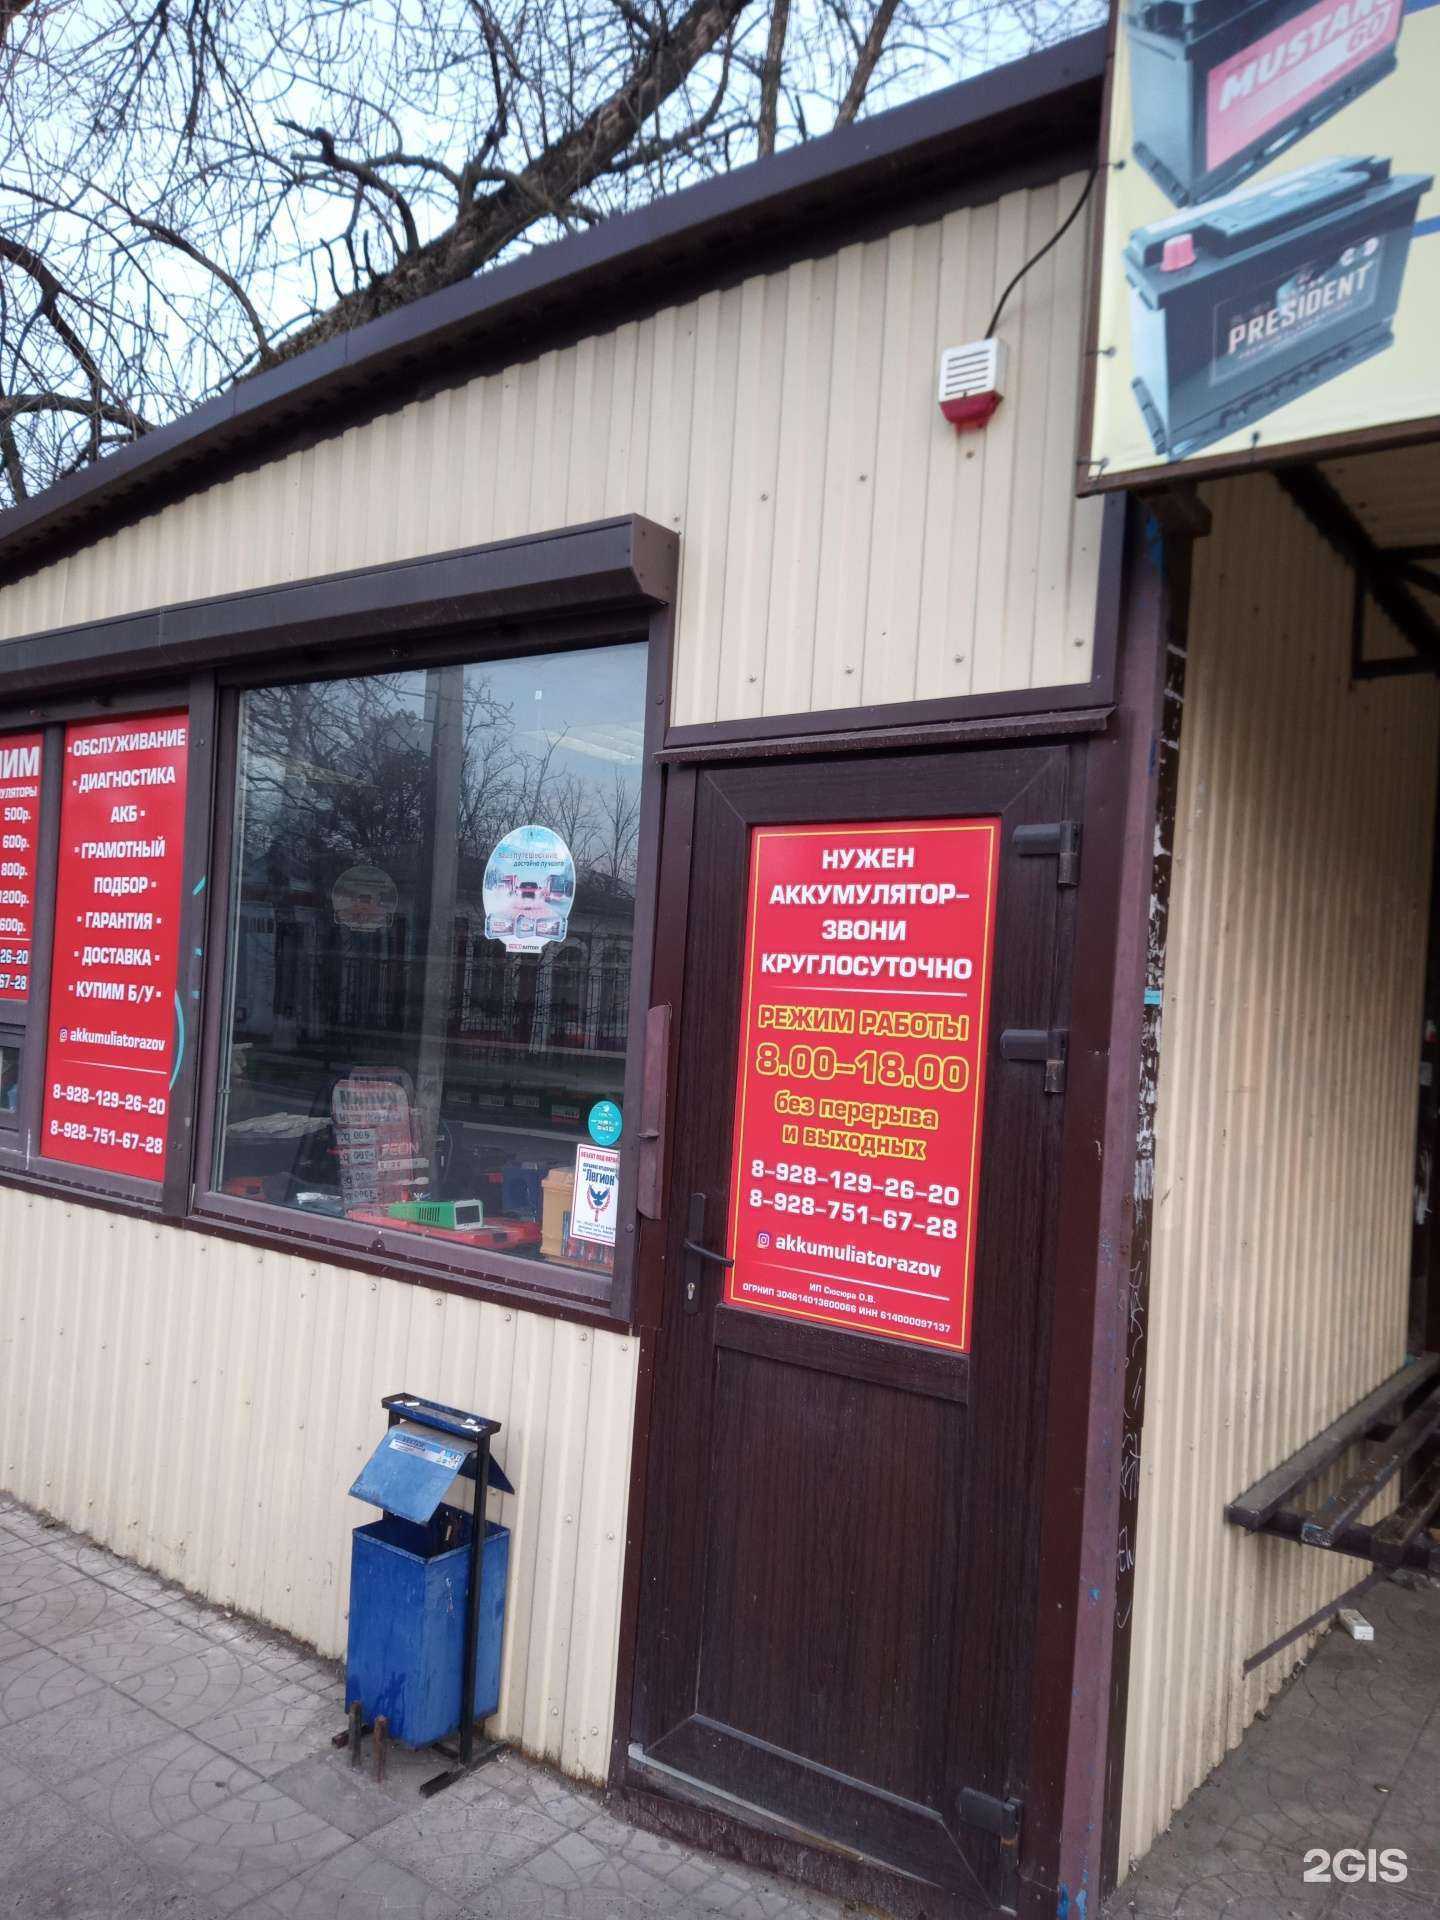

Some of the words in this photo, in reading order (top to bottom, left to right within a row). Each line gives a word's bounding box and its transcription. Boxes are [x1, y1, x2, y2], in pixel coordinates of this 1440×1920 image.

[1219, 0, 1386, 111] MUSTAN
[1228, 260, 1374, 354] PRESIDENT
[73, 728, 186, 756] ОБСЛУЖИВАНИЕ
[78, 766, 176, 793] ДИАГНОСТИКА
[4, 807, 32, 824] 500р.
[110, 805, 138, 823] АКБ
[2, 835, 30, 852] 600р.
[81, 836, 166, 859] ГРАМОТНЫЙ
[1, 862, 28, 879] 800р.
[822, 847, 915, 869] НУЖЕН
[94, 876, 148, 897] ПОДБОР
[769, 883, 970, 905] АККУМУЛЯТОР-
[85, 911, 153, 930] ГАРАНТИЯ
[822, 920, 906, 941] ЗВОНИ
[81, 946, 152, 967] ДОСТАВКА
[761, 953, 972, 980] КРУГЛОСУТОЧНО
[75, 981, 124, 1000] КУПИМ
[128, 985, 154, 1004] Б/У
[758, 1004, 853, 1033] РЕЖИМ
[859, 1008, 969, 1041] РАБОТЫ
[70, 1027, 165, 1051] akkumuliatorazov
[756, 1042, 969, 1092] 8.00-18.00
[52, 1083, 166, 1116] 8-928-129-26-20
[774, 1090, 814, 1114] без
[819, 1097, 938, 1130] перерыва
[50, 1119, 164, 1154] 8-928-751-67-28
[783, 1124, 798, 1144] и
[803, 1126, 927, 1161] выходных
[752, 1160, 959, 1206] 8-928-129-26-20
[749, 1189, 958, 1239] 8-928-751-67-28
[775, 1234, 941, 1278] akkumuliatorazov
[809, 1282, 822, 1293] ИП
[859, 1292, 877, 1304] О.В.
[742, 1282, 774, 1297] ОГРНИП
[859, 1306, 879, 1318] ИНН
[880, 1310, 951, 1333] 614000097137
